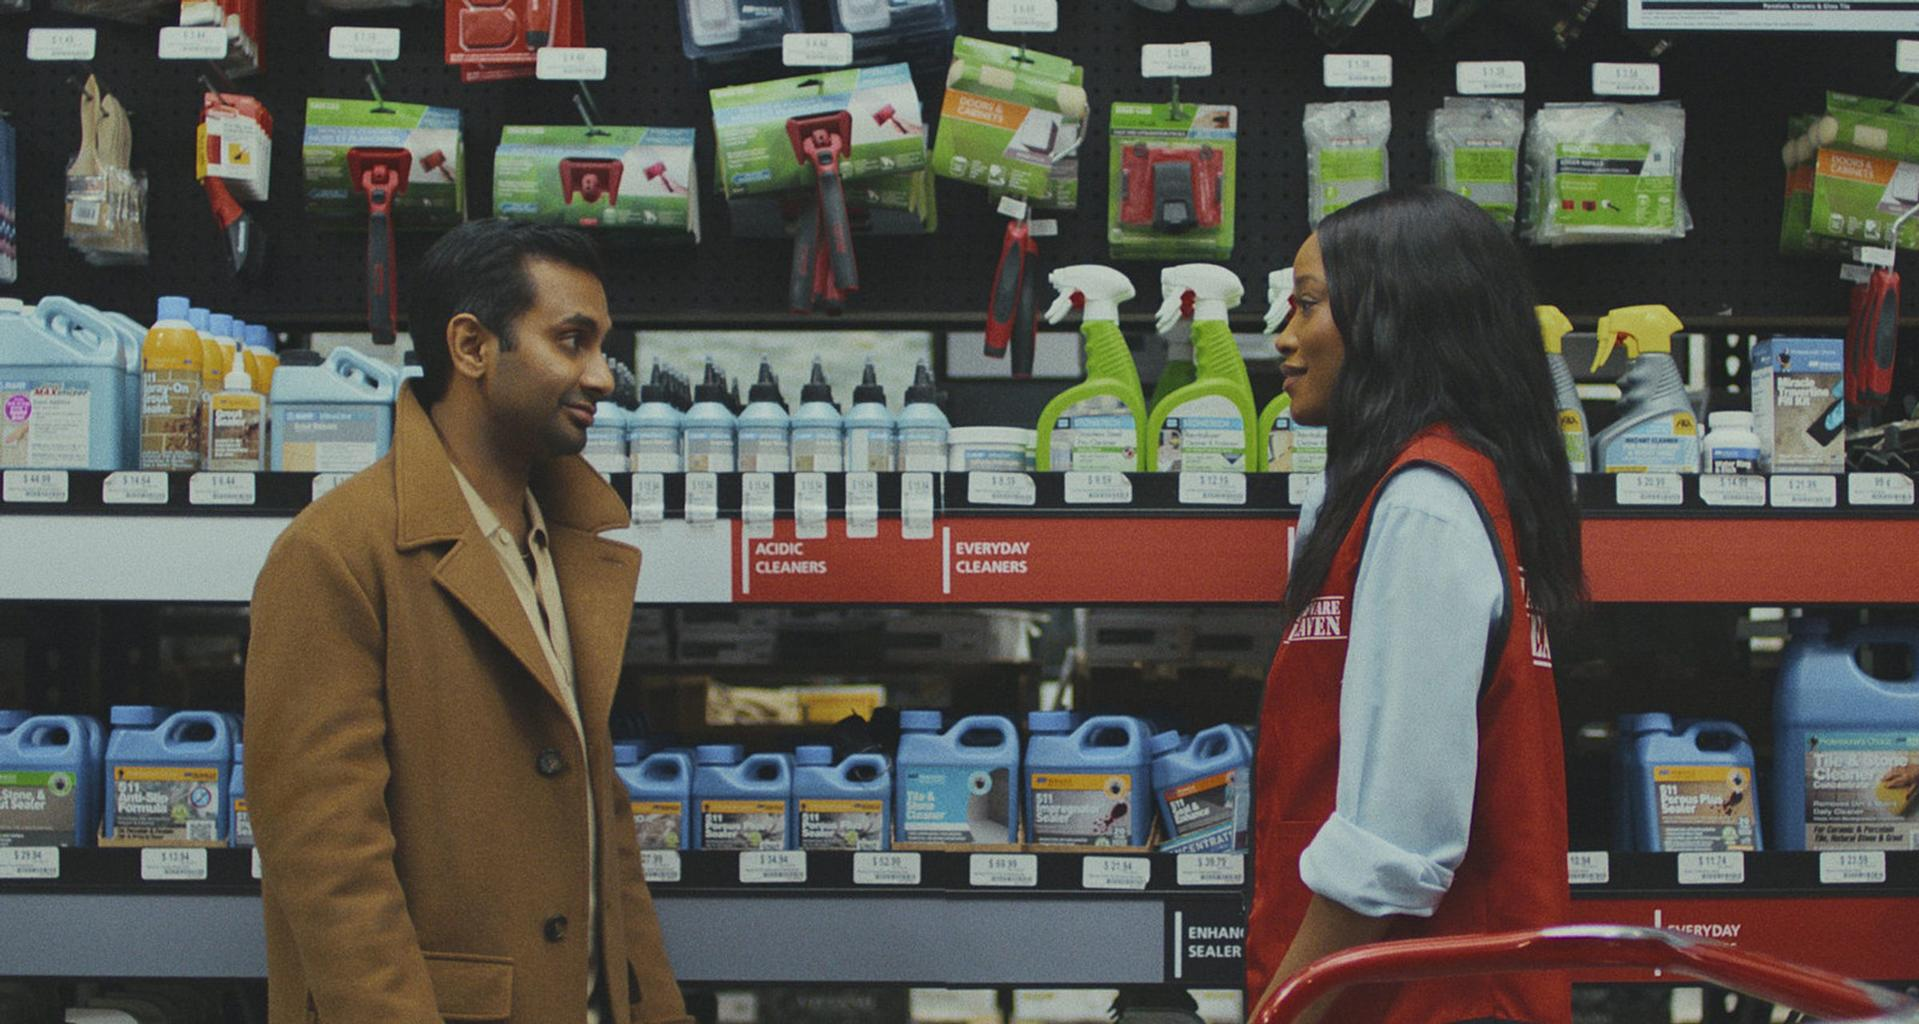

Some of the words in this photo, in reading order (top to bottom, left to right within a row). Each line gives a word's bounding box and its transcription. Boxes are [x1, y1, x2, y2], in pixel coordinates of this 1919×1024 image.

[959, 97, 993, 109] DOORS
[755, 542, 804, 556] ACIDIC
[956, 542, 1030, 556] EVERYDAY
[755, 560, 828, 574] CLEANERS
[956, 560, 1028, 574] CLEANERS
[1814, 753, 1843, 768] Tile
[1849, 753, 1860, 768] &
[1813, 768, 1875, 781] Cleaner
[37, 789, 46, 800] &
[118, 792, 169, 805] Anti-Slip
[11, 799, 47, 811] Sealer
[118, 802, 168, 814] Formula
